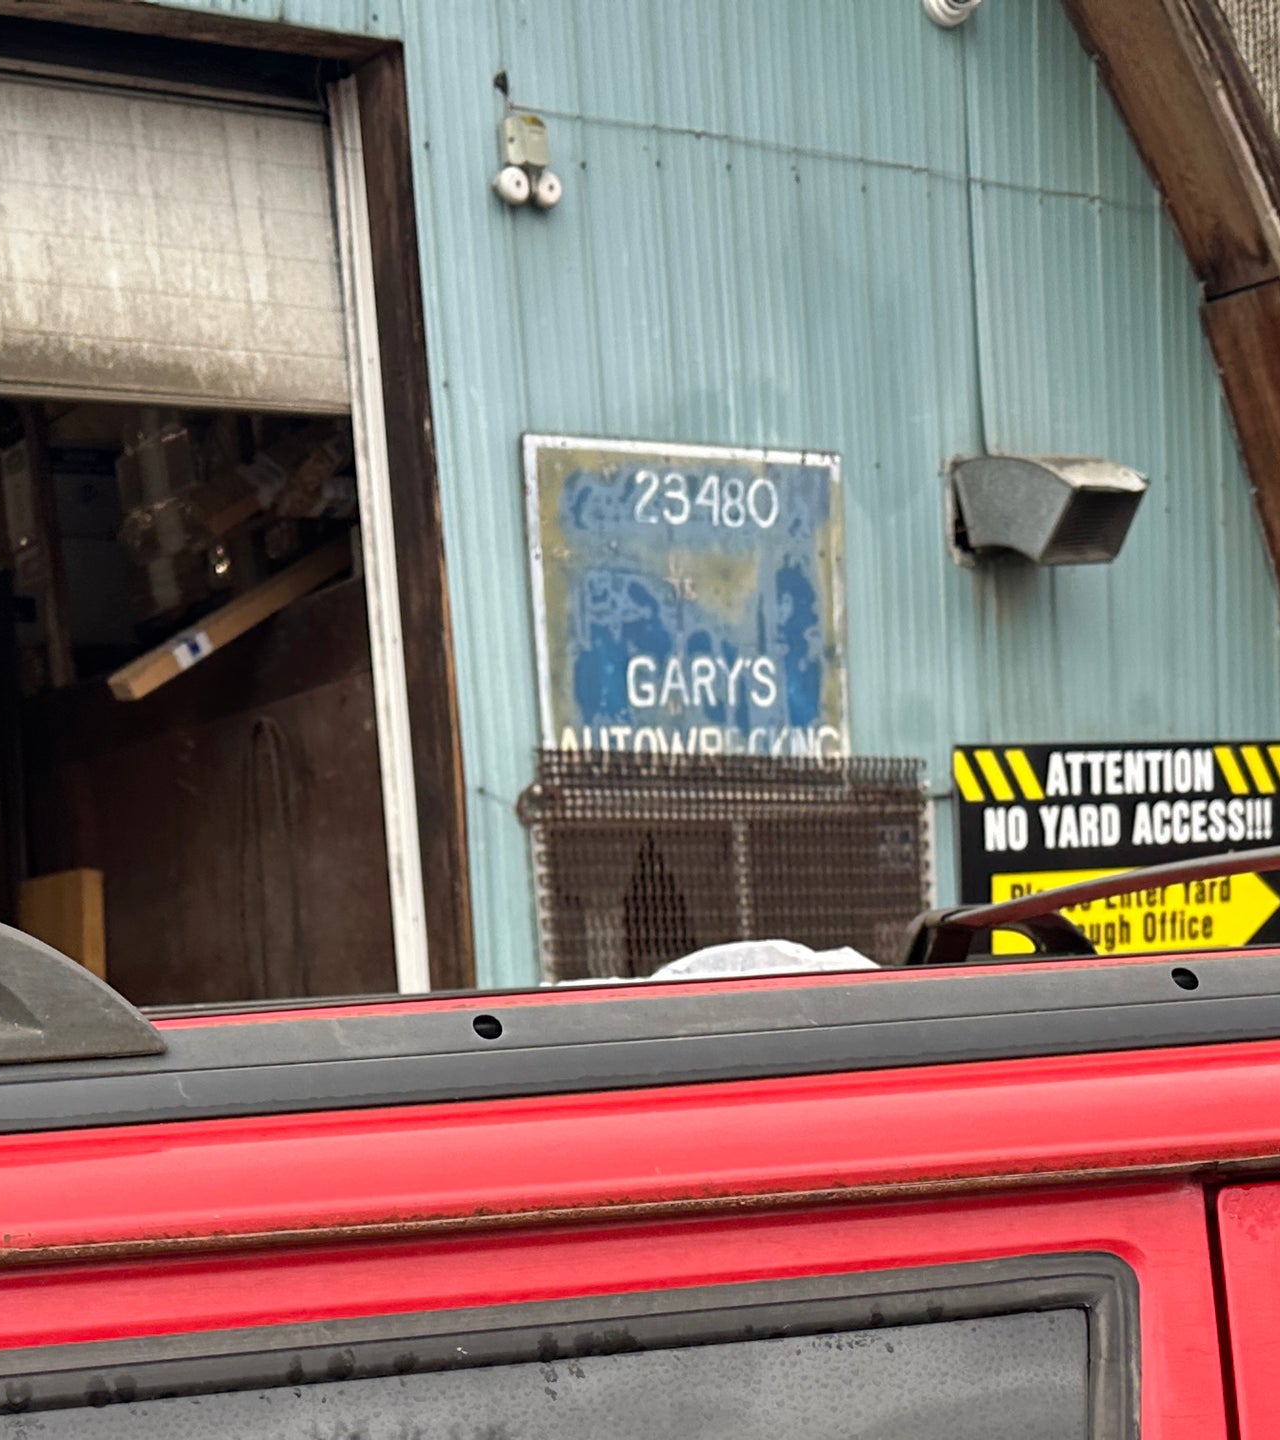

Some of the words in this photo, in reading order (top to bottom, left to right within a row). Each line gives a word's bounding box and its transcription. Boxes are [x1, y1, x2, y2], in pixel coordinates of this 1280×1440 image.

[634, 469, 780, 529] 23480
[626, 655, 778, 707] GARY'S
[1045, 748, 1215, 797] ATTENTION
[983, 805, 1030, 852] NO
[1039, 802, 1122, 850] YARD
[1131, 798, 1273, 846] ACCESS!!!
[1142, 909, 1214, 943] Office
